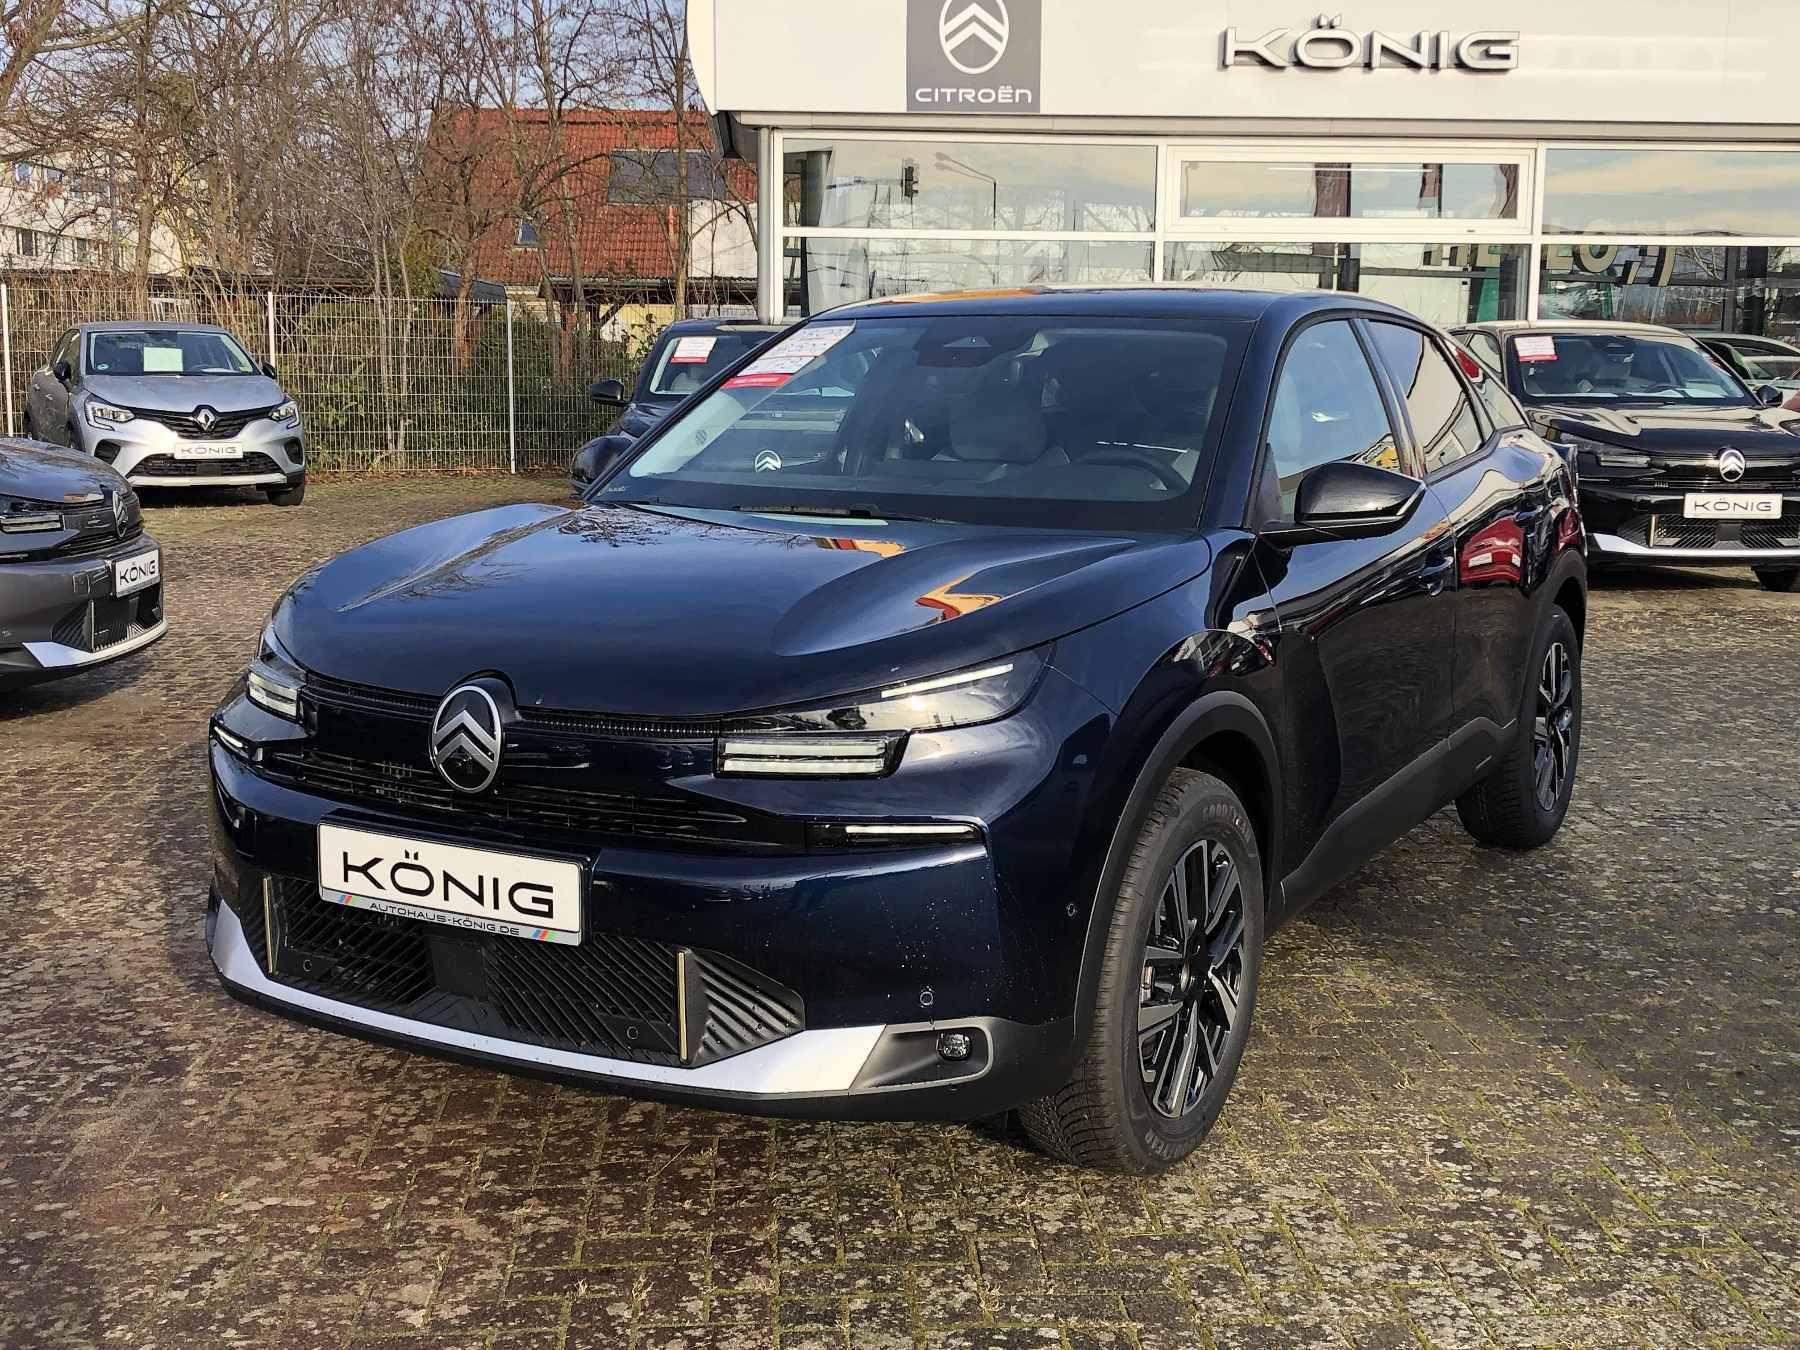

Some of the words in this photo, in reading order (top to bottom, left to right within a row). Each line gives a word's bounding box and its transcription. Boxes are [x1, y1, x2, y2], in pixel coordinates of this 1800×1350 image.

[1219, 14, 1520, 72] KÖNIG
[1694, 497, 1772, 512] KÖNIG
[119, 559, 156, 585] KÖNIG
[343, 849, 554, 919] KÖNIG
[369, 902, 520, 936] AUTOHAUS-KÖNIG.DE
